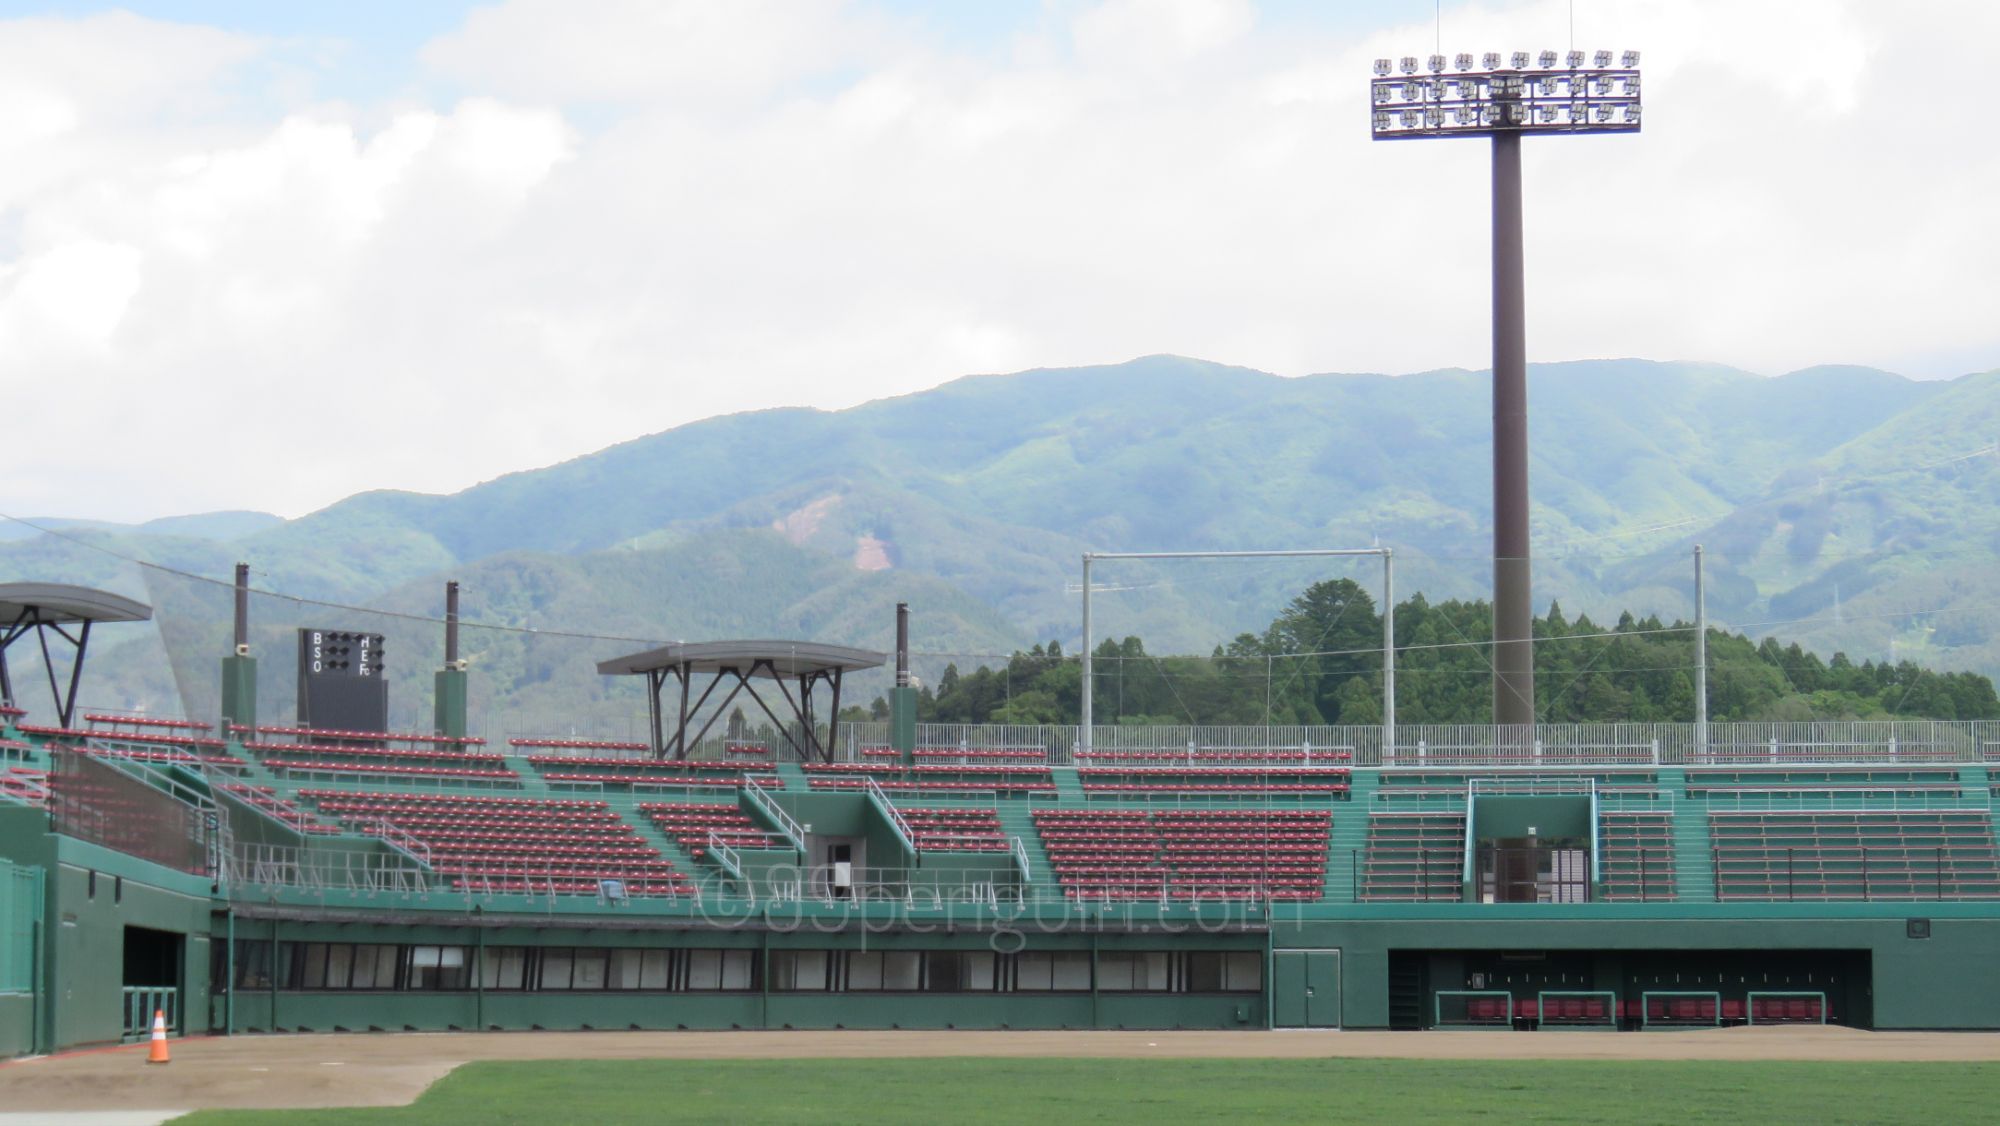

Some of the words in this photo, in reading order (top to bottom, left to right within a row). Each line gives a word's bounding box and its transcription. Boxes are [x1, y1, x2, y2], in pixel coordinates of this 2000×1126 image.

[313, 632, 322, 645] B
[361, 636, 370, 648] H
[314, 646, 321, 659] S
[361, 650, 369, 662] E
